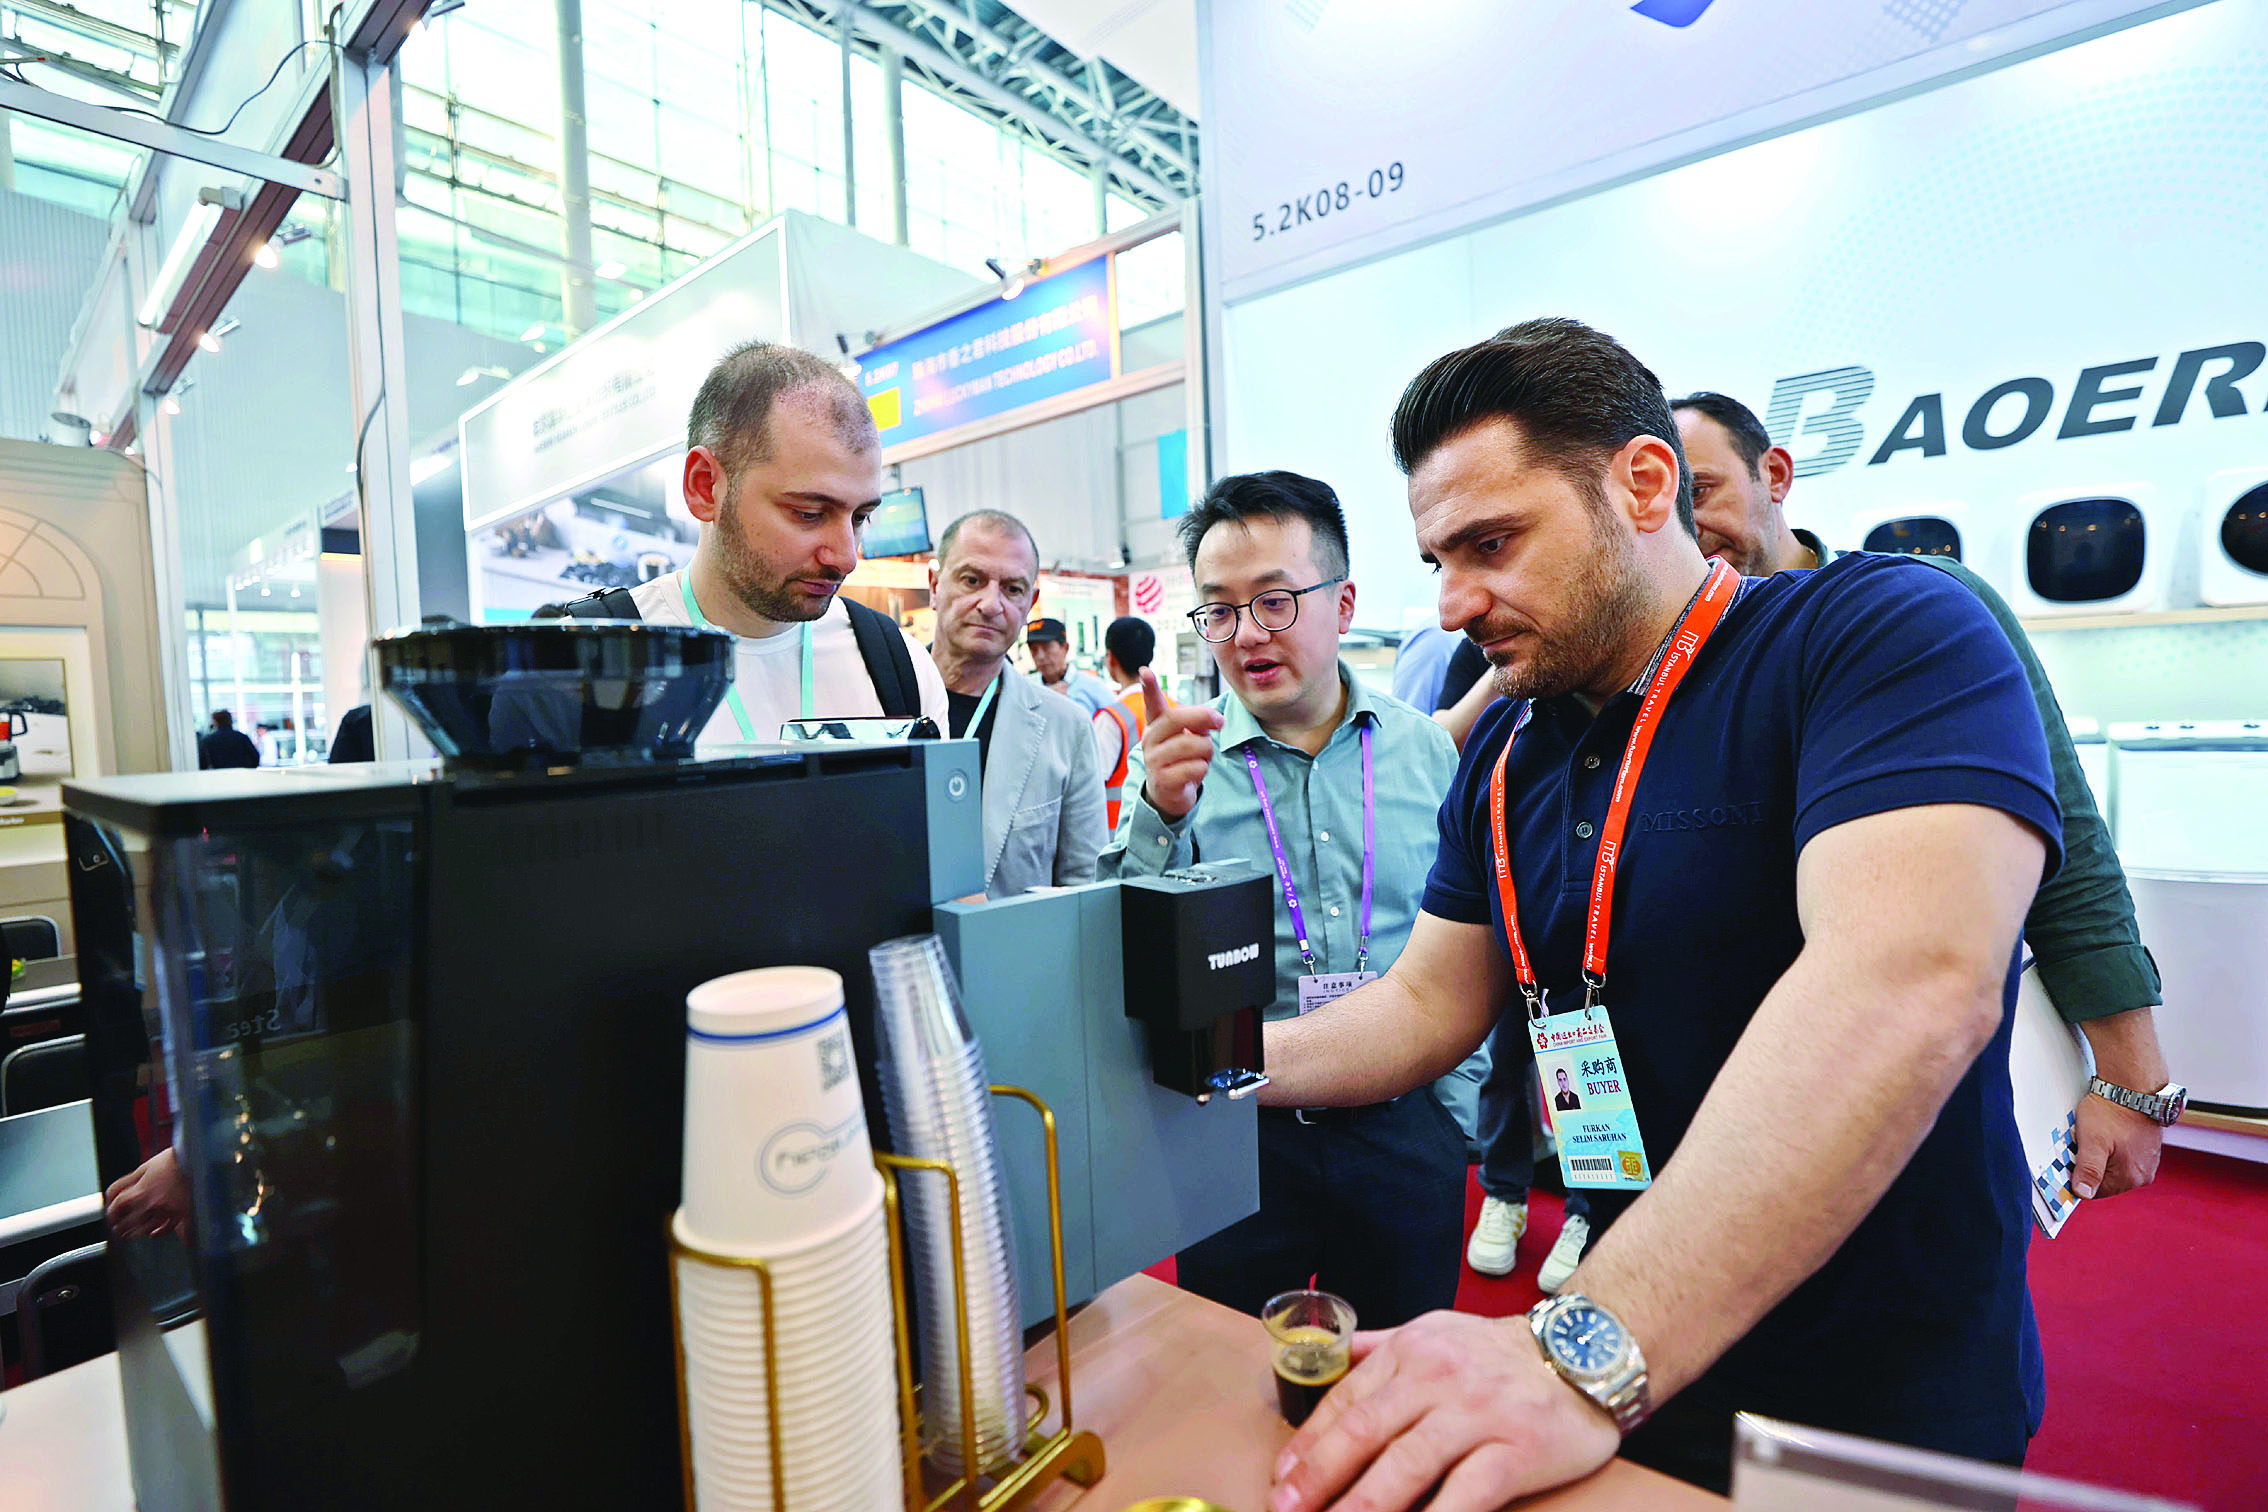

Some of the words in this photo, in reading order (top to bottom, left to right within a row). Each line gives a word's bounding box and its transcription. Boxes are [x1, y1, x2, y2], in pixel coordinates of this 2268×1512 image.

[1253, 161, 1405, 242] 5.2K08-09
[1766, 340, 2268, 479] BAOER
[1639, 688, 1662, 723] TRAVEL
[1640, 801, 1764, 832] MISSONI
[1590, 904, 1601, 940] TRAVEL
[1581, 1056, 1617, 1078] 采购商
[1587, 1080, 1622, 1095] BUYER
[1572, 1134, 1593, 1144] SELIM
[1593, 1132, 1627, 1143] SARUHAN
[1582, 1123, 1611, 1133] FURKAN
